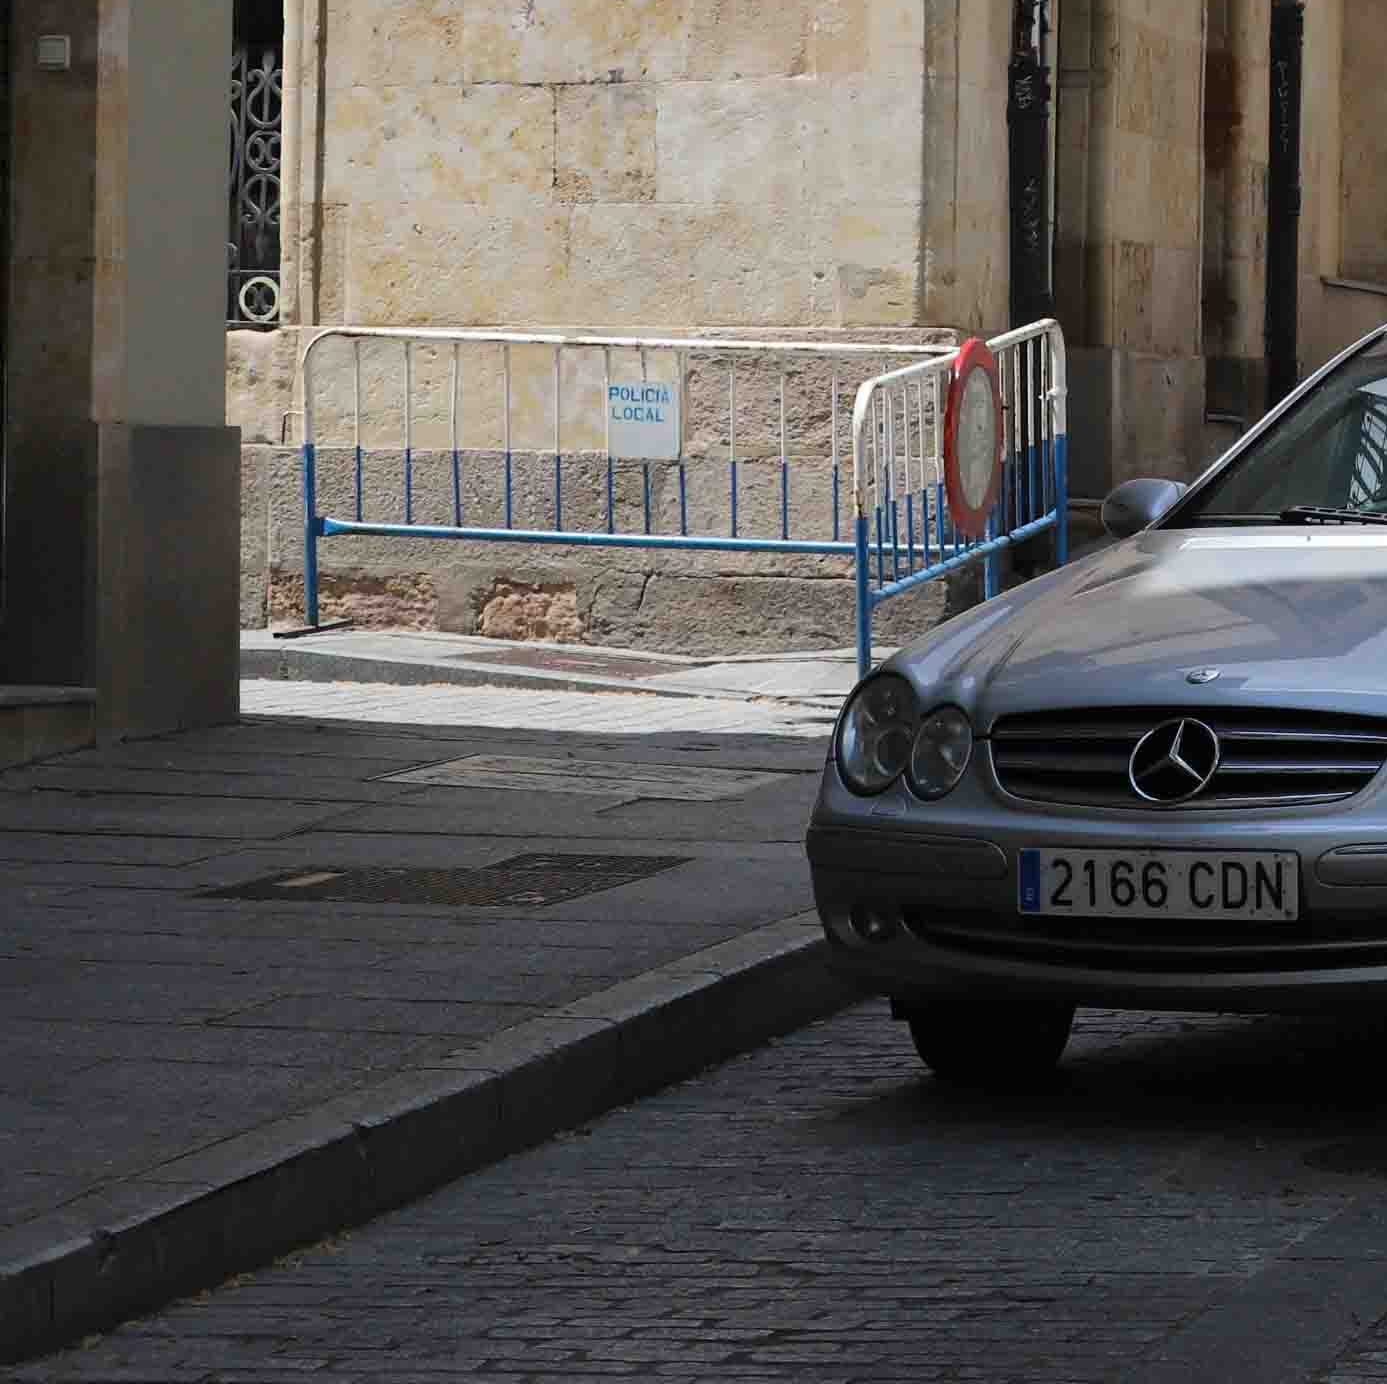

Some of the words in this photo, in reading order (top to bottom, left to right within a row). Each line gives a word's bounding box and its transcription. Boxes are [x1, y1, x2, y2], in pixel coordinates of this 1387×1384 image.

[611, 406, 665, 423] LOCAL
[1051, 858, 1169, 908] 2166
[1188, 860, 1284, 911] CDN
